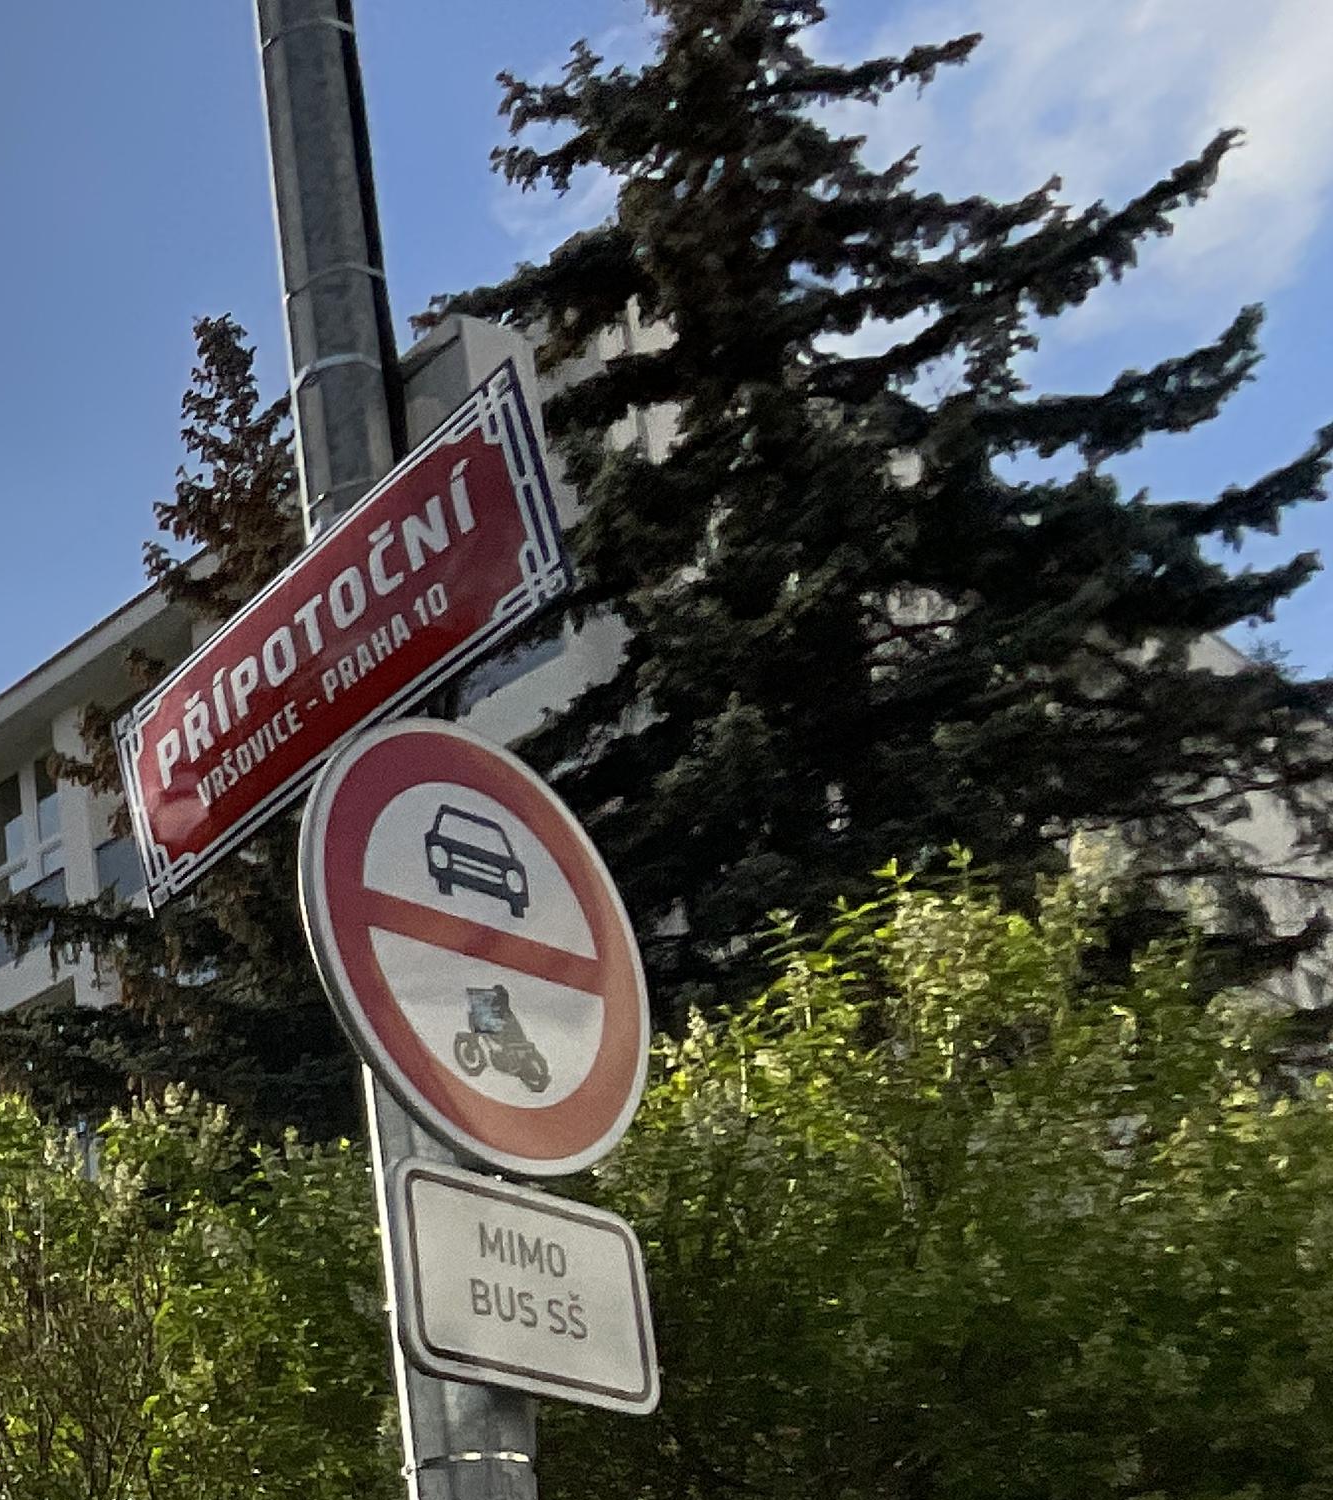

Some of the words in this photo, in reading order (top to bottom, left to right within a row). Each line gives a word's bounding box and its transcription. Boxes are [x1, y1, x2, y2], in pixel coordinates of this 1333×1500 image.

[156, 459, 476, 790] PŘÍPOTOČNÍ
[196, 704, 303, 808] VRŠOVICE
[321, 621, 411, 704] PRAHA
[413, 582, 449, 628] 10
[469, 1278, 538, 1328] BUS
[547, 1290, 588, 1339] SŠ
[478, 1222, 567, 1278] MIMO
